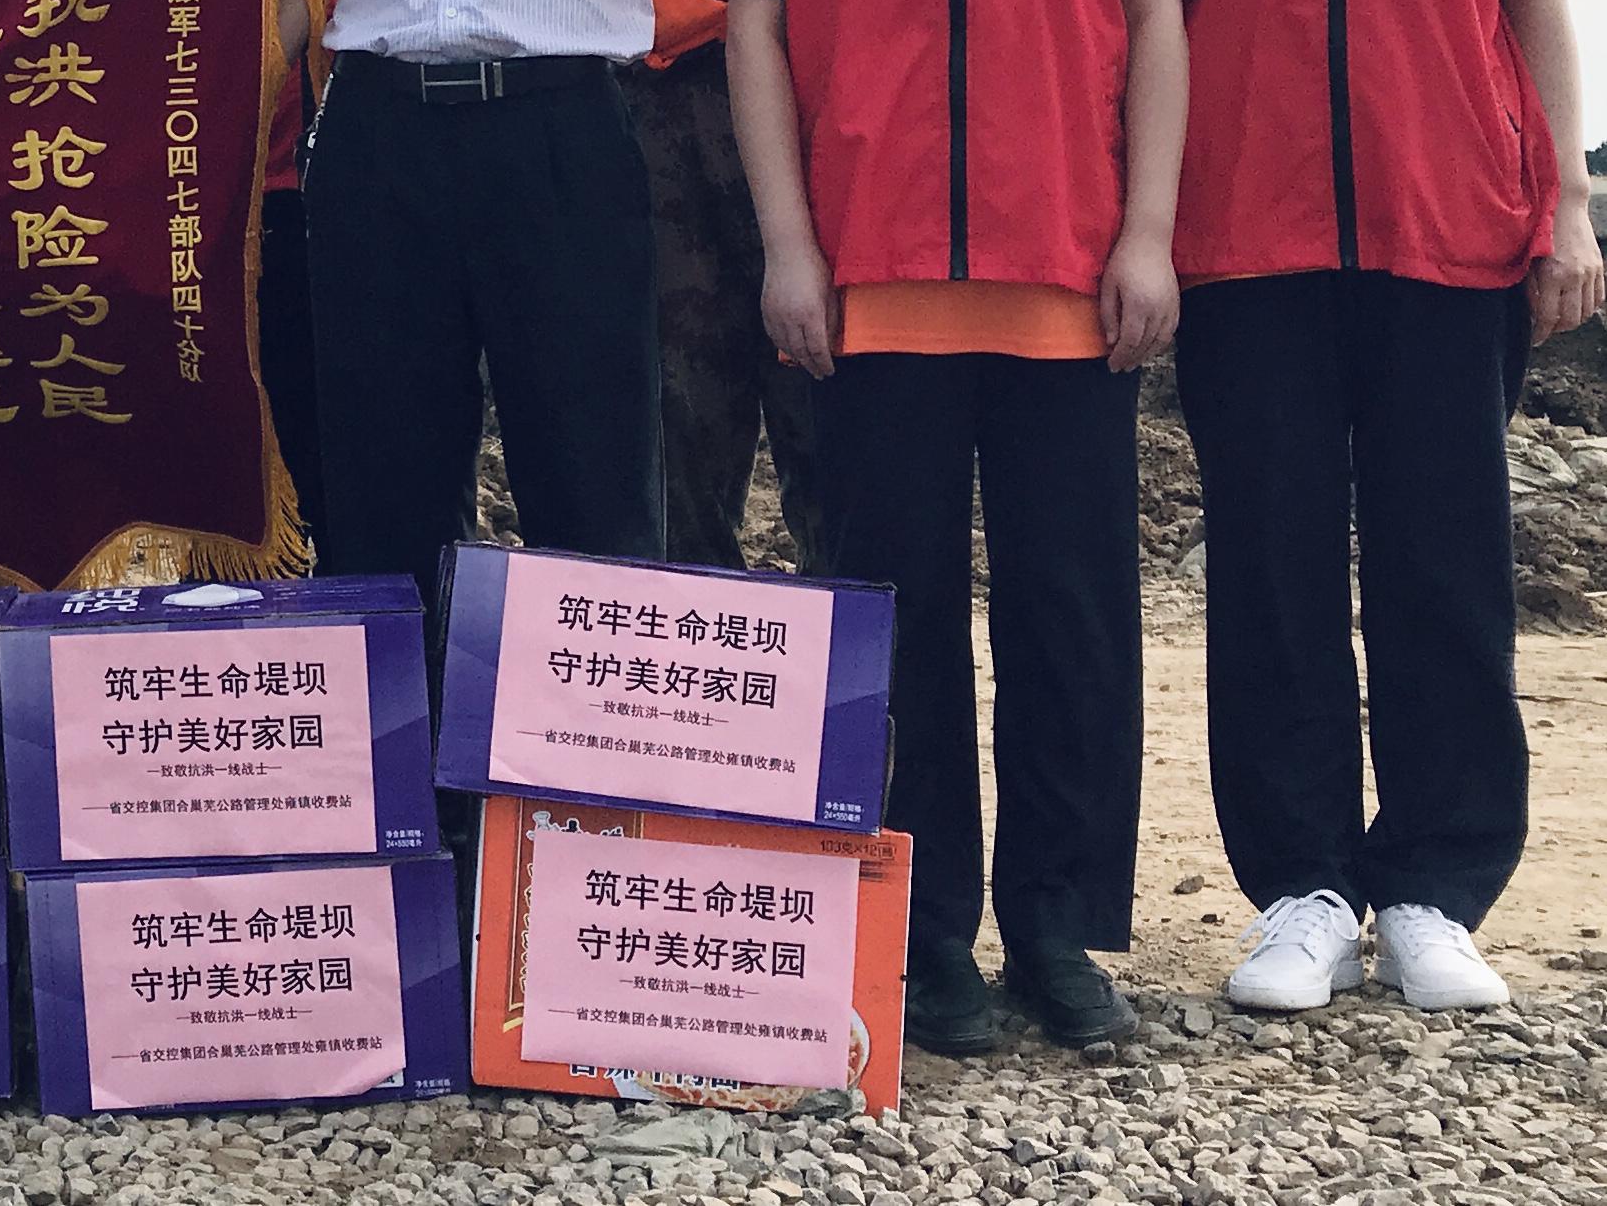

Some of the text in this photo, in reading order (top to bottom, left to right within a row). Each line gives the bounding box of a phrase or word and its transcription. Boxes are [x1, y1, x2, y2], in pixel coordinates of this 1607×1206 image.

[557, 593, 787, 657] 筑牢生命堤坝
[104, 662, 328, 702] 筑牢生命堤坝
[548, 647, 778, 709] 守护美好家园
[102, 714, 323, 755] 守护美好家园
[585, 869, 815, 925] 筑牢生命堤坝
[132, 903, 356, 949] 筑牢生命堤坝
[577, 924, 806, 979] 守护美好家园
[130, 957, 352, 1002] 守护美好家园
